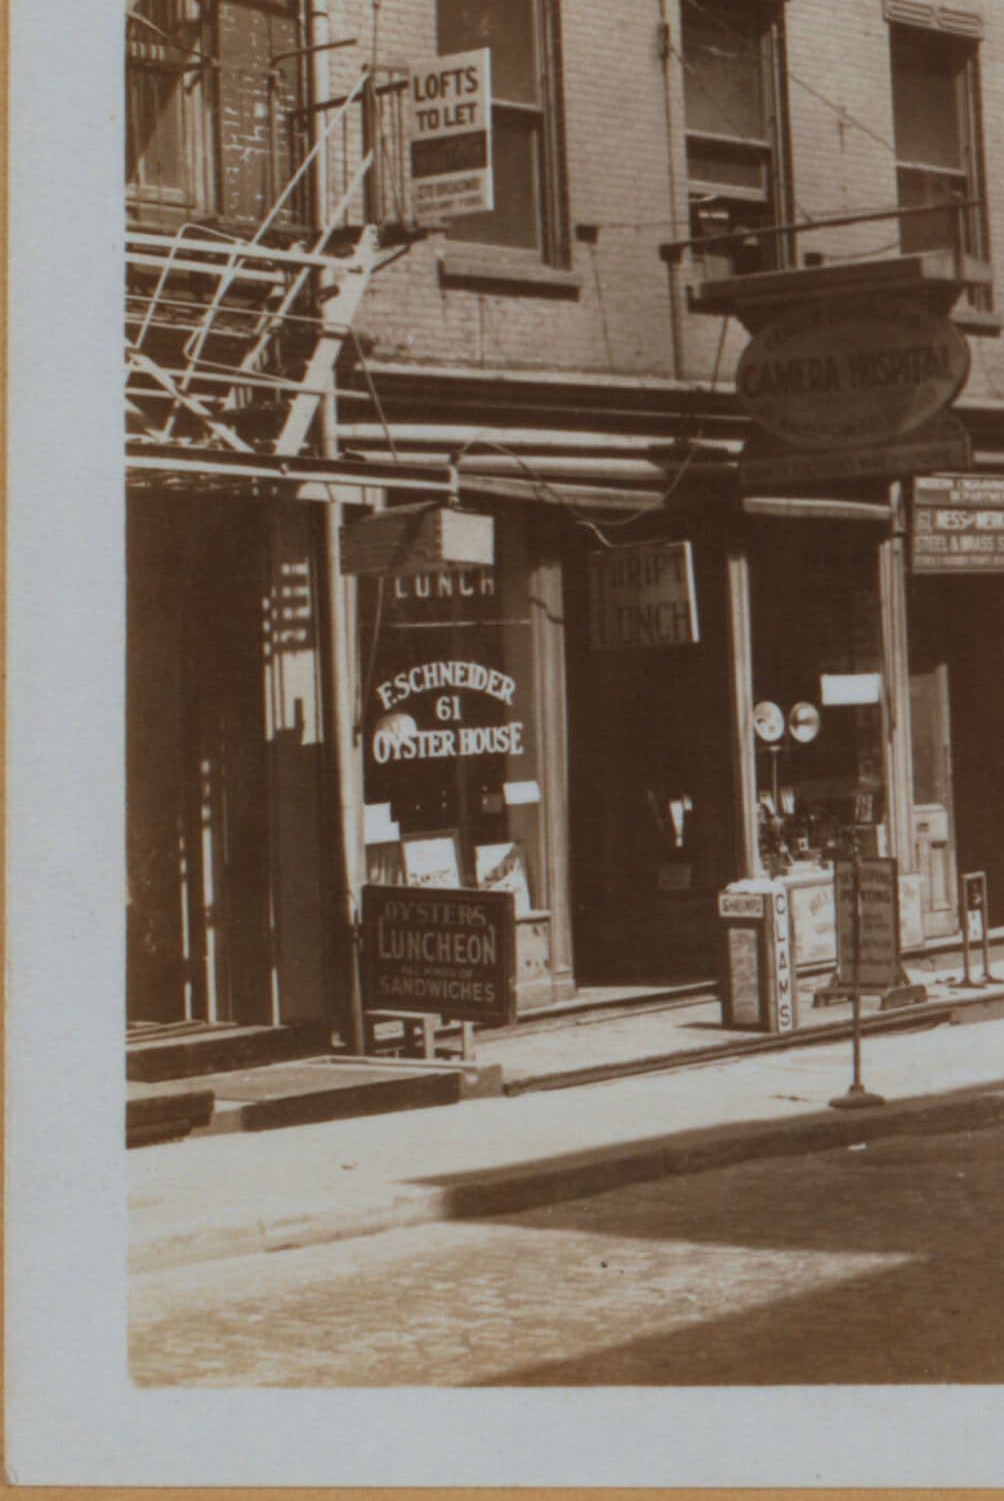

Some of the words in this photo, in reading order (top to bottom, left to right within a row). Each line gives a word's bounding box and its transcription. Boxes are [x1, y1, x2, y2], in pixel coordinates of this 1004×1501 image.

[413, 67, 479, 102] LOFTS
[415, 108, 440, 132] TO
[444, 102, 478, 127] LET
[435, 695, 462, 721] 61
[373, 729, 456, 764] OYSTER
[458, 722, 525, 756] HOUSE
[378, 916, 497, 965] LUNCHEON
[775, 893, 790, 1027] CLAMS
[379, 975, 496, 1003] SANDWICHES
